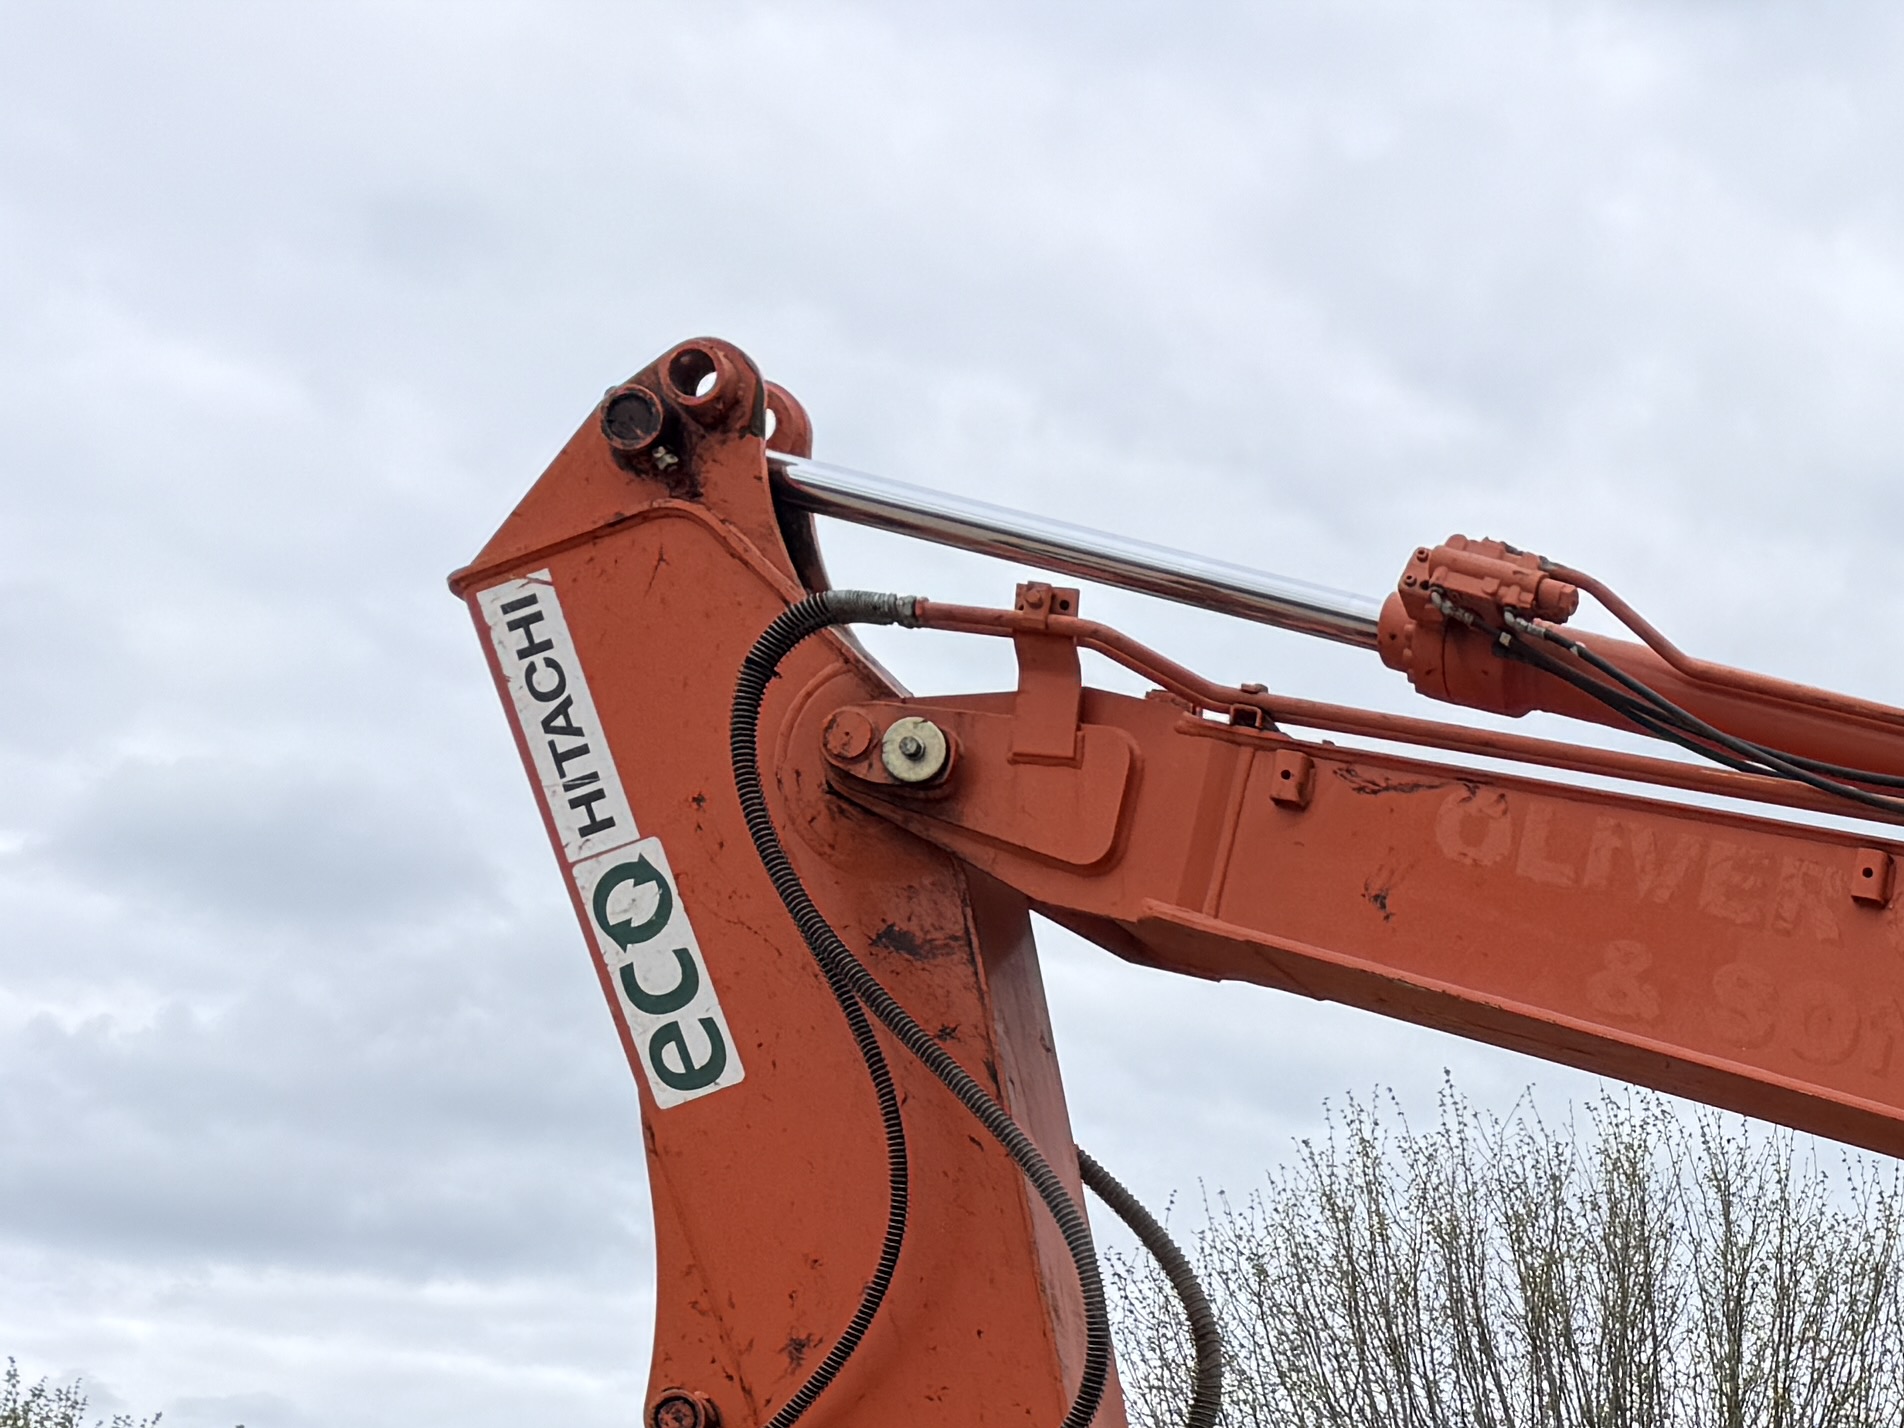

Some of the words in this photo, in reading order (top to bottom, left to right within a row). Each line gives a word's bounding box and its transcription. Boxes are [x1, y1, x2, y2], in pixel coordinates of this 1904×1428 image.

[501, 592, 617, 839] HITACHI
[1435, 788, 1843, 943] OLIVER
[1585, 939, 1662, 1022] &
